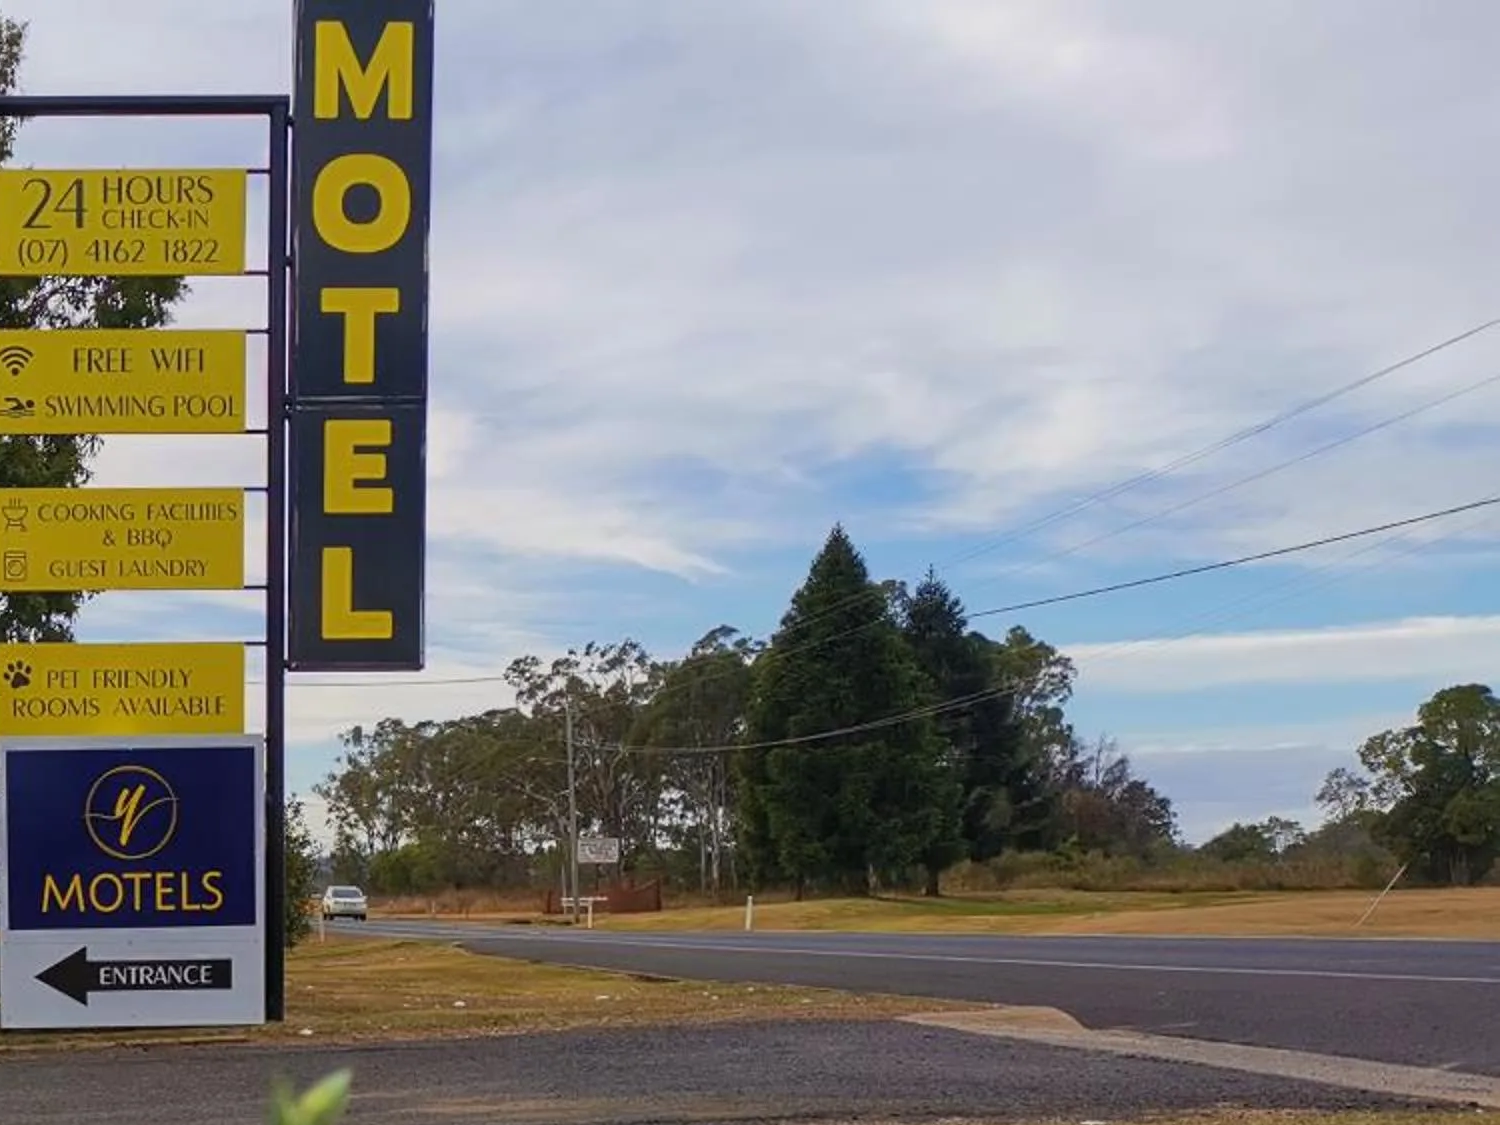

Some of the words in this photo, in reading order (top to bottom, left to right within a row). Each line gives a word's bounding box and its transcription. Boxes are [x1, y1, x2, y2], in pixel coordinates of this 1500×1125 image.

[21, 178, 88, 229] 24
[103, 176, 213, 205] HOURS
[102, 209, 209, 229] CHECK-IN
[18, 237, 68, 267] (07)
[85, 239, 145, 263] 4162
[163, 239, 219, 263] 1822
[313, 20, 413, 640] MOTEL
[73, 347, 134, 373] FREE
[150, 347, 204, 373] WIFI
[45, 394, 164, 417] SWIMMING
[173, 394, 240, 417] POOL
[37, 503, 135, 522] COOKING
[147, 502, 237, 521] FACILITIES
[102, 529, 116, 546] &
[127, 528, 172, 549] BBQ
[49, 560, 106, 578] GUEST
[119, 559, 209, 577] LAUNDRY
[47, 669, 80, 689] PET
[93, 669, 193, 689] FRIENDLY
[13, 697, 100, 718] ROOMS
[114, 695, 226, 717] AVAILABLE
[41, 871, 224, 913] MOTELS
[100, 963, 213, 986] ENTRANCE
